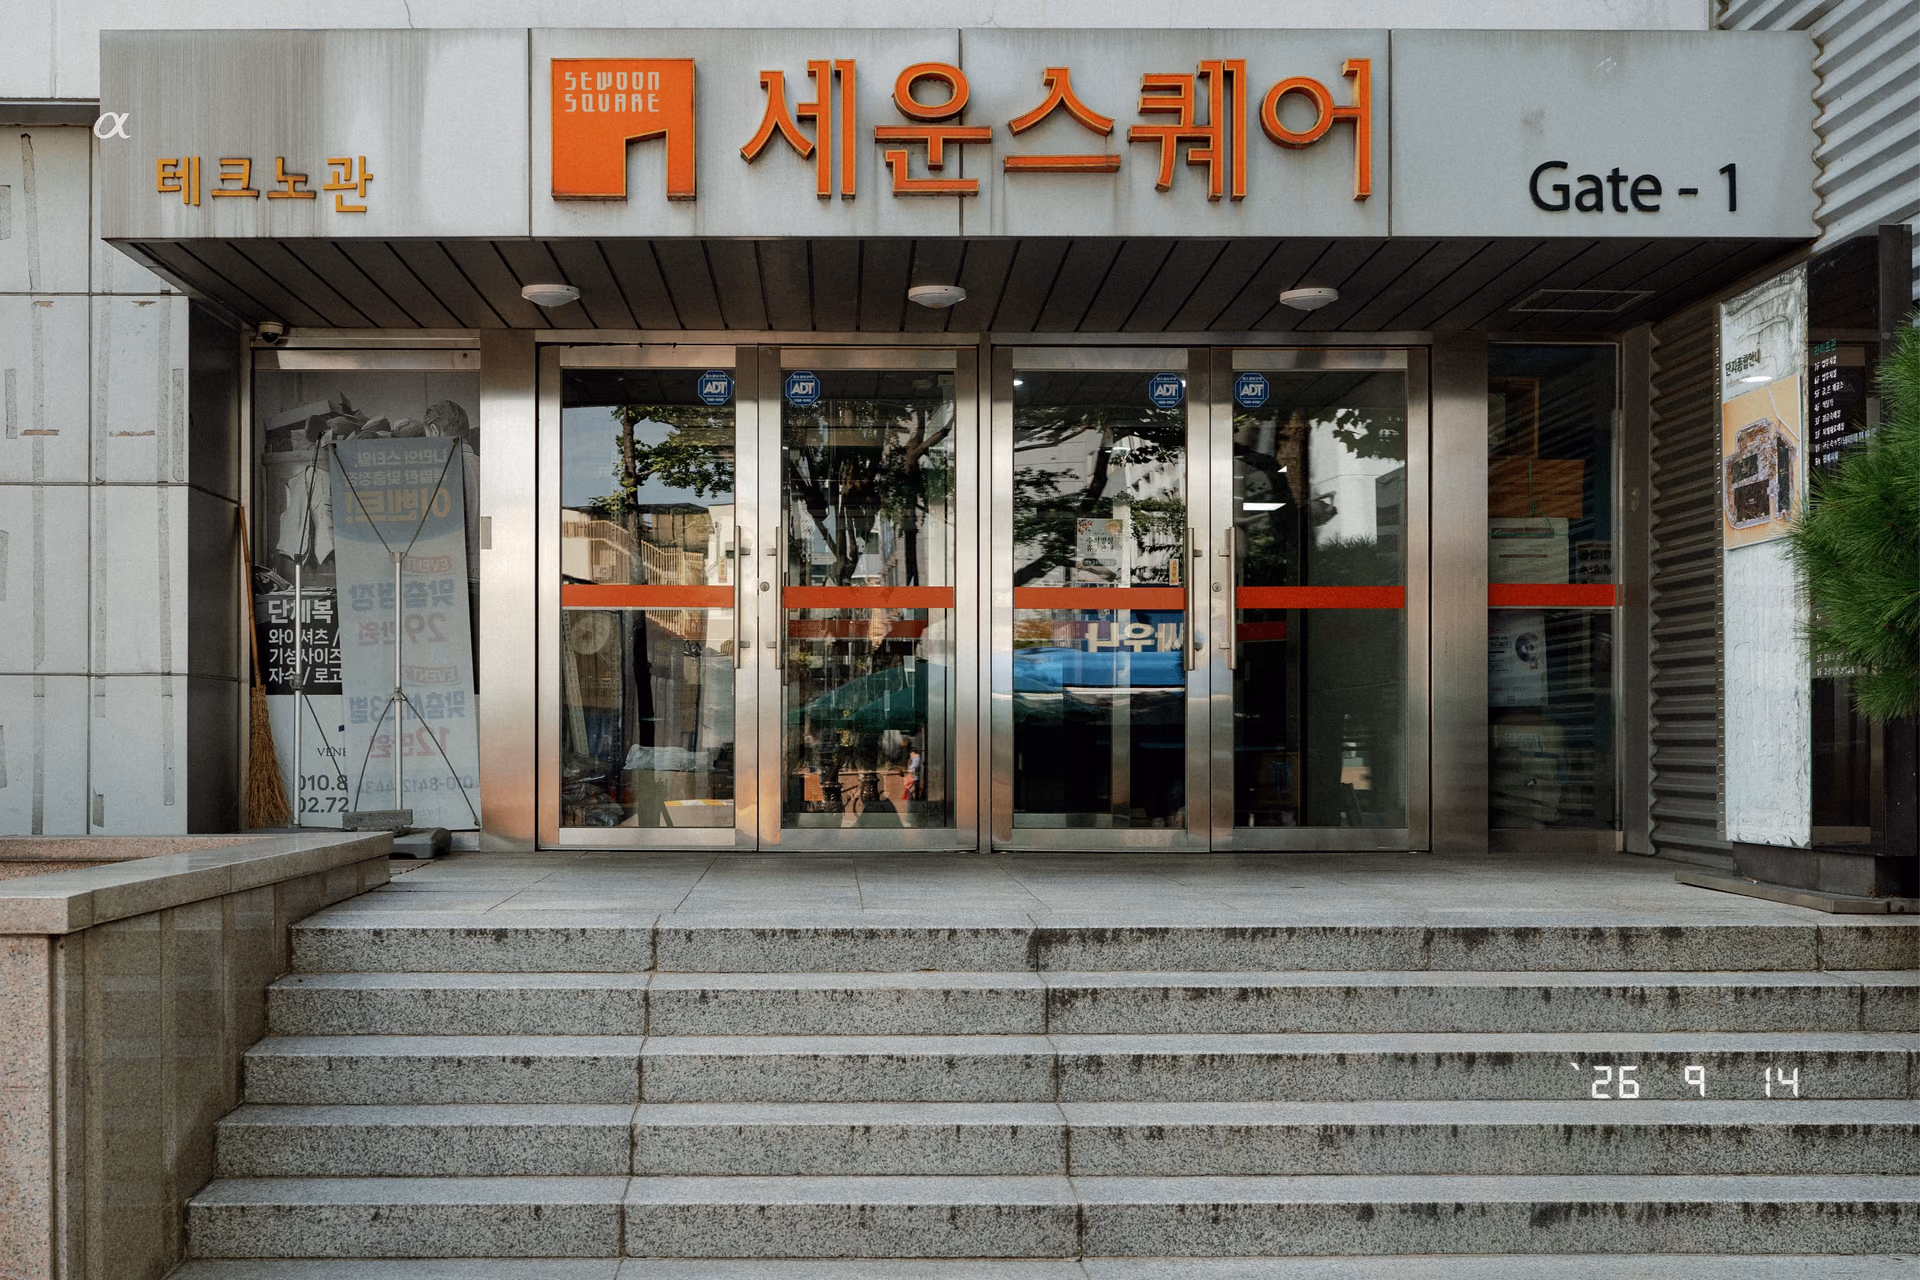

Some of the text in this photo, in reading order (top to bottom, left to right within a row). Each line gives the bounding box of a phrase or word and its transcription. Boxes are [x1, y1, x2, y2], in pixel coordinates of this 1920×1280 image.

[564, 71, 660, 91] SEWOON
[564, 93, 660, 113] SQUARE
[740, 58, 1372, 201] 세운스퀘어
[156, 155, 373, 212] 테크노관
[1529, 160, 1662, 213] Gate
[1718, 162, 1737, 212] 1
[704, 381, 728, 394] ADT
[791, 381, 815, 394] ADT
[1154, 384, 1178, 396] ADT
[1240, 384, 1264, 396] ADT
[268, 599, 333, 624] 단체복
